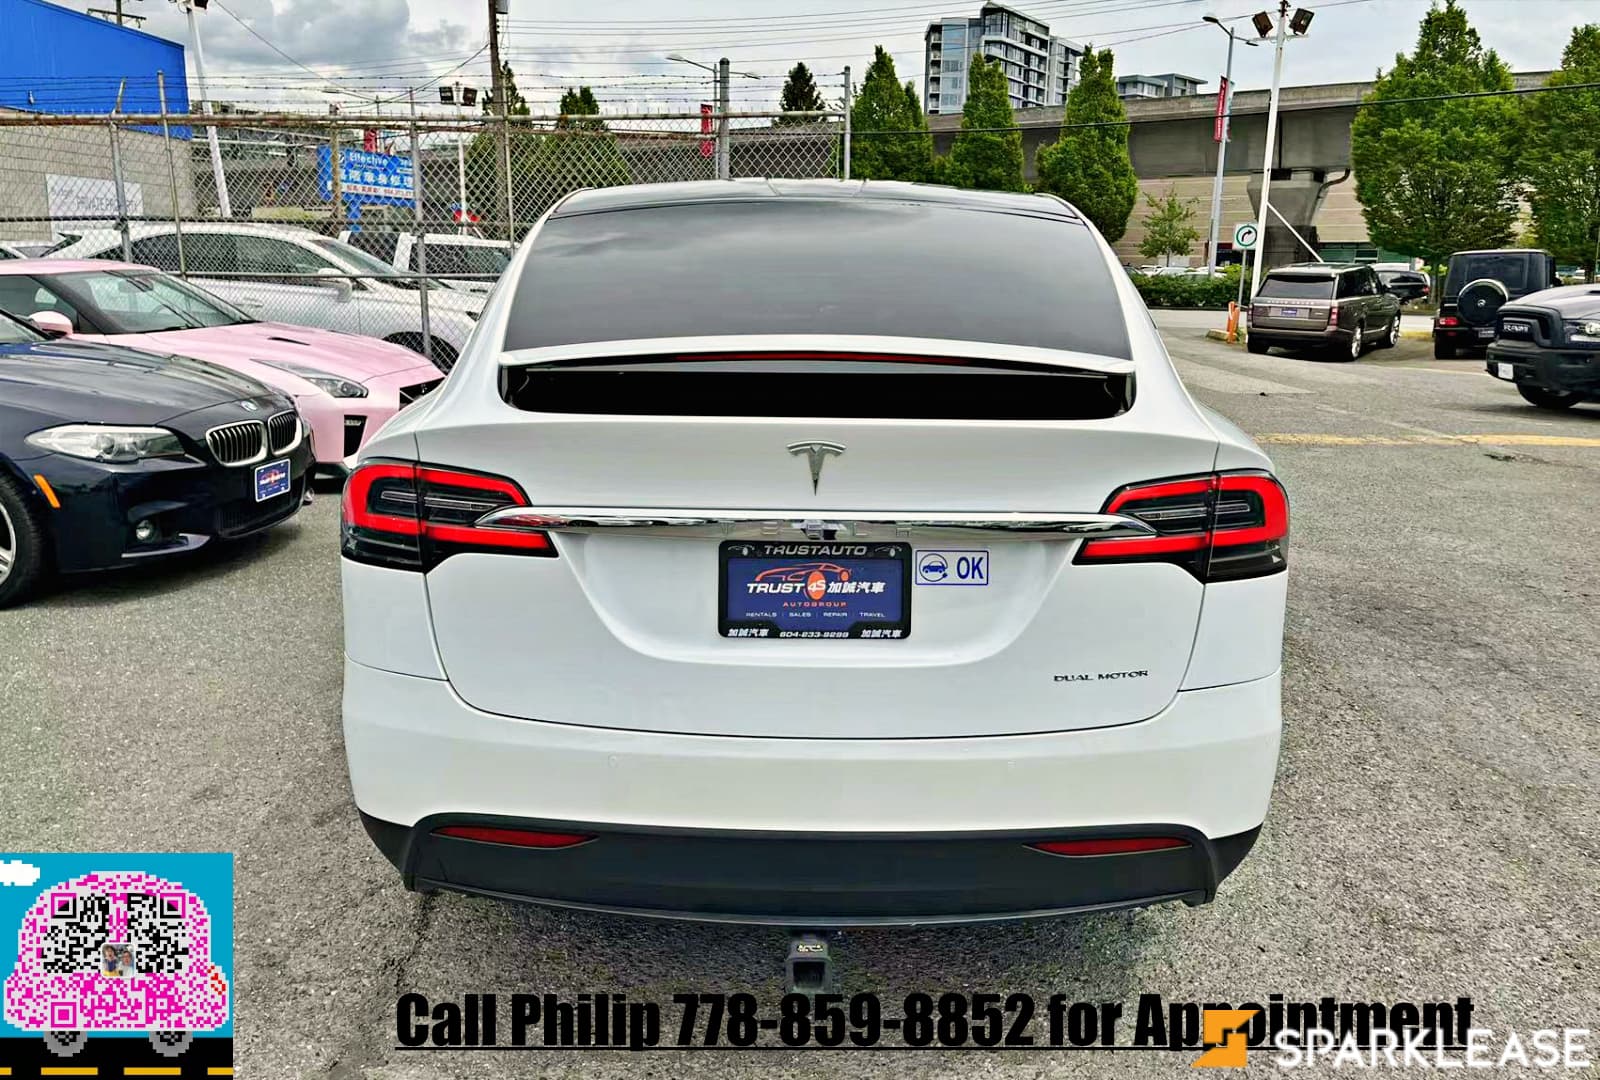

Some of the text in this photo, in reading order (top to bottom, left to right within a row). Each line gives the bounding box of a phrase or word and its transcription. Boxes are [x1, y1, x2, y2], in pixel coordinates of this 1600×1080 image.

[763, 544, 867, 556] TRUSTAUTO
[956, 556, 984, 580] OK
[746, 583, 805, 594] TRUST
[1053, 670, 1149, 682] DUAL MOTOR
